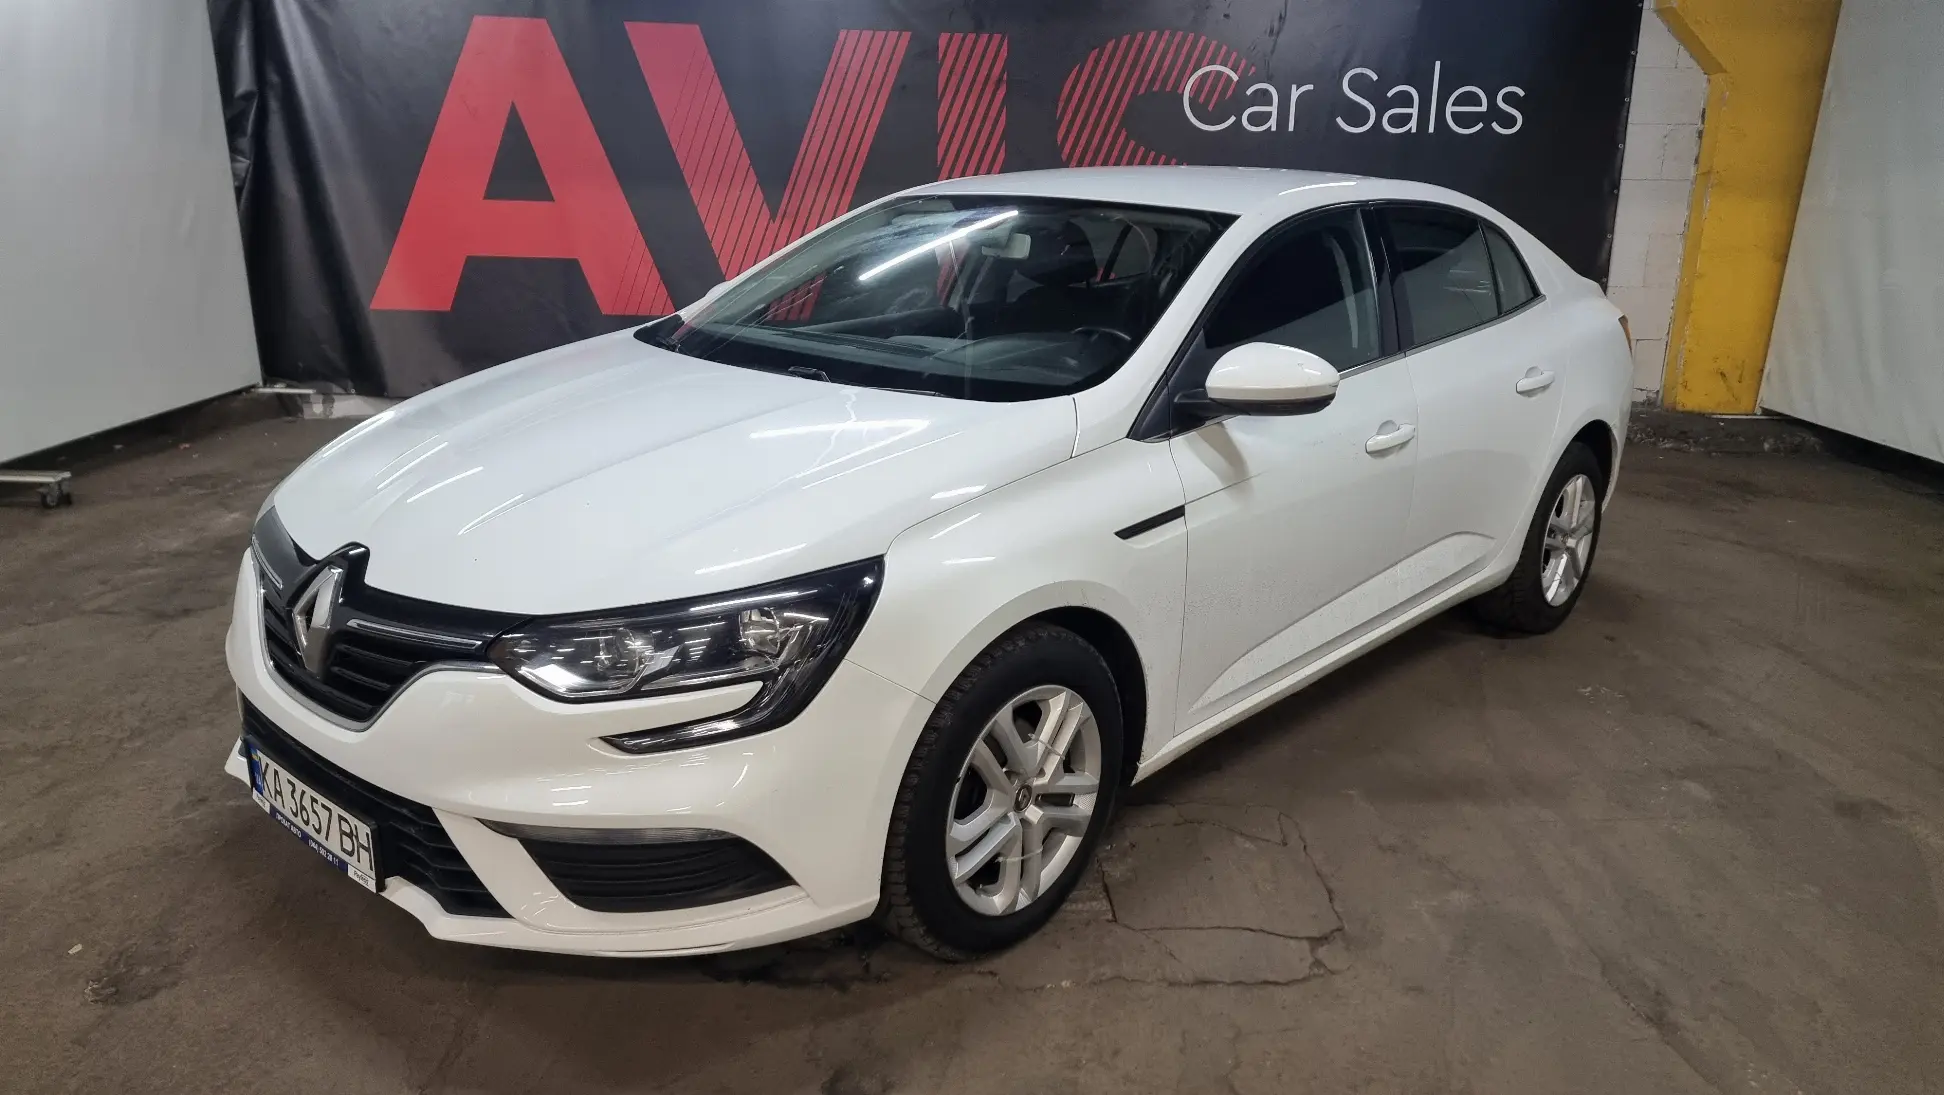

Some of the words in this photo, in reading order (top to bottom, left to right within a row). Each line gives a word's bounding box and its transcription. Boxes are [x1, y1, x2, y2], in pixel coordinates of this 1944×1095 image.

[1183, 64, 1314, 133] Car
[1336, 60, 1526, 135] Sales
[259, 756, 286, 811] KA
[287, 777, 333, 842] 3657
[337, 813, 374, 872] BH
